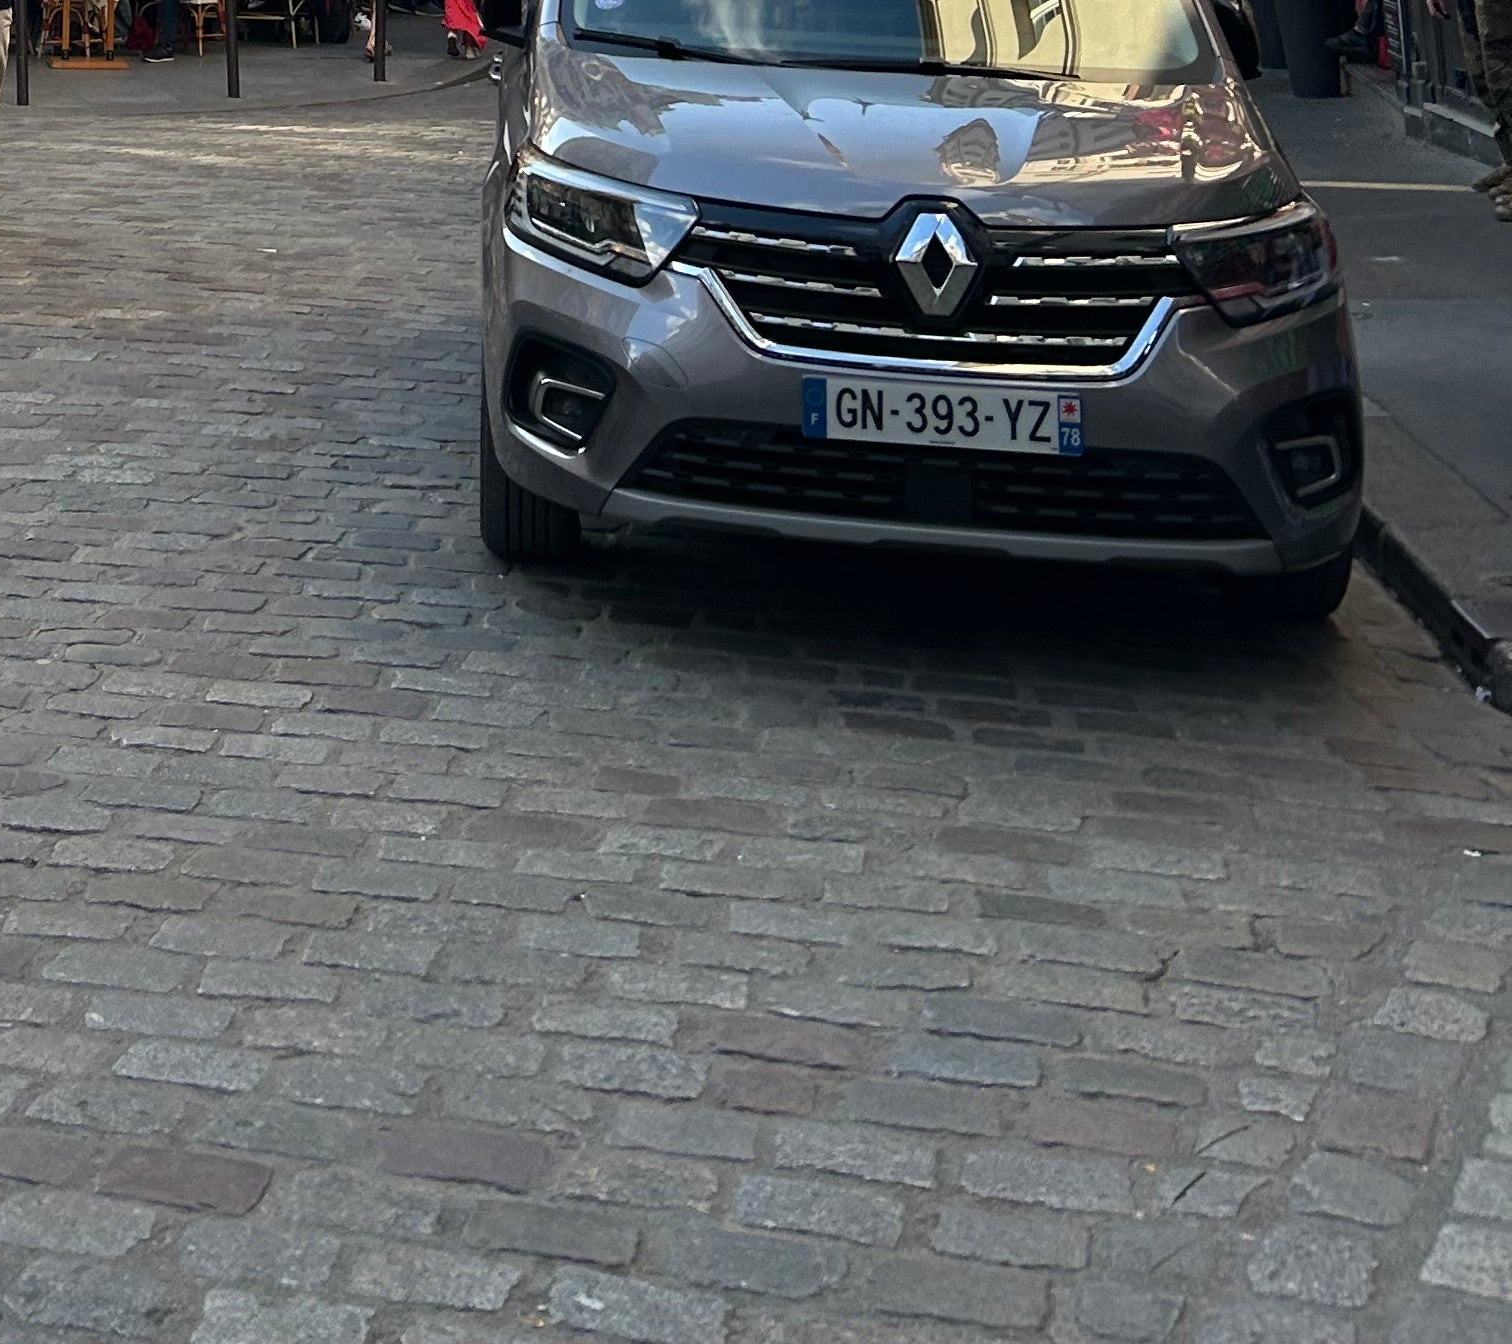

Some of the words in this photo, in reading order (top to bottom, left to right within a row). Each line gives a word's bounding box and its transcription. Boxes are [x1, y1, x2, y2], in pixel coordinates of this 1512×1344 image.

[810, 413, 819, 426] F
[836, 386, 1052, 443] GN-393-YZ
[1061, 427, 1081, 447] 78
